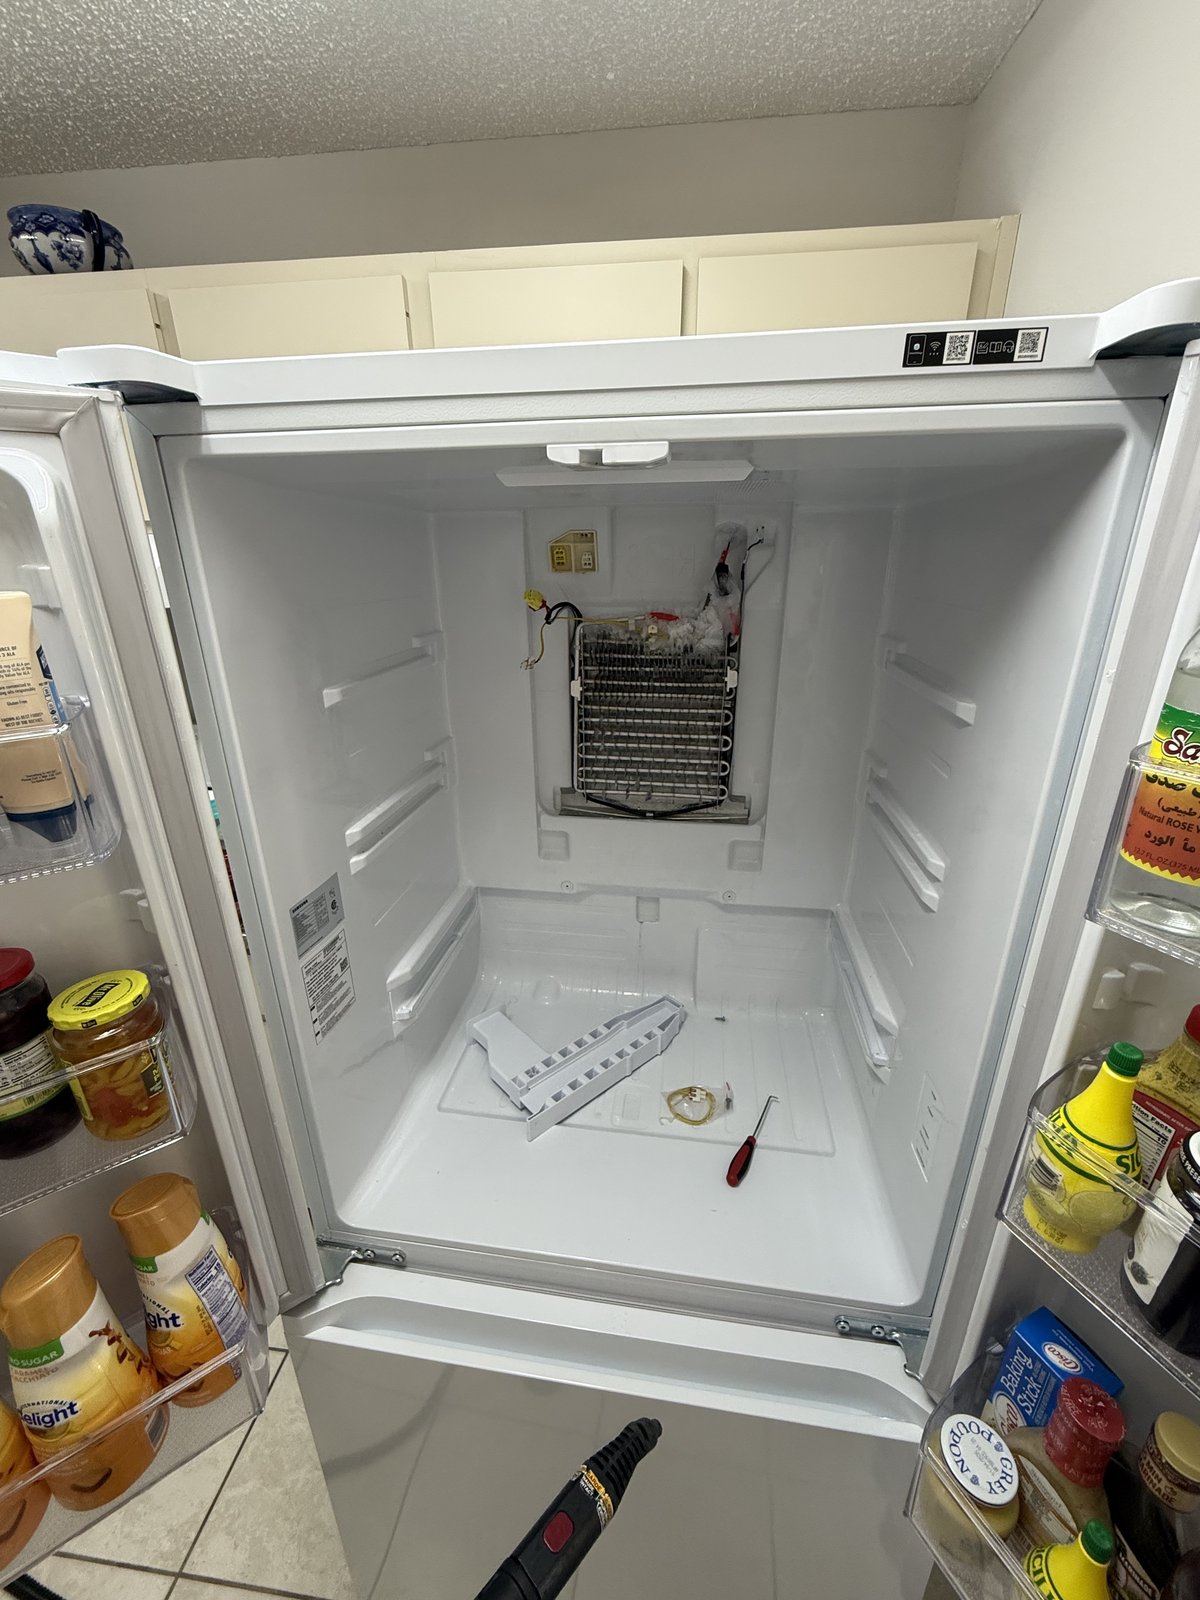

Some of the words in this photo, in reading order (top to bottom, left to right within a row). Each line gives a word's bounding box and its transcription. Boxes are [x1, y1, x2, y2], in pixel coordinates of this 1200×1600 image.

[1166, 817, 1195, 833] ROSE
[1150, 1115, 1173, 1135] Facts
[20, 1350, 60, 1367] SUGAR
[1000, 1345, 1034, 1397] Baking
[1047, 1345, 1080, 1371] Crisco
[1016, 1374, 1042, 1417] Stick
[949, 1420, 995, 1475] POUPON
[985, 1456, 1014, 1496] GREY
